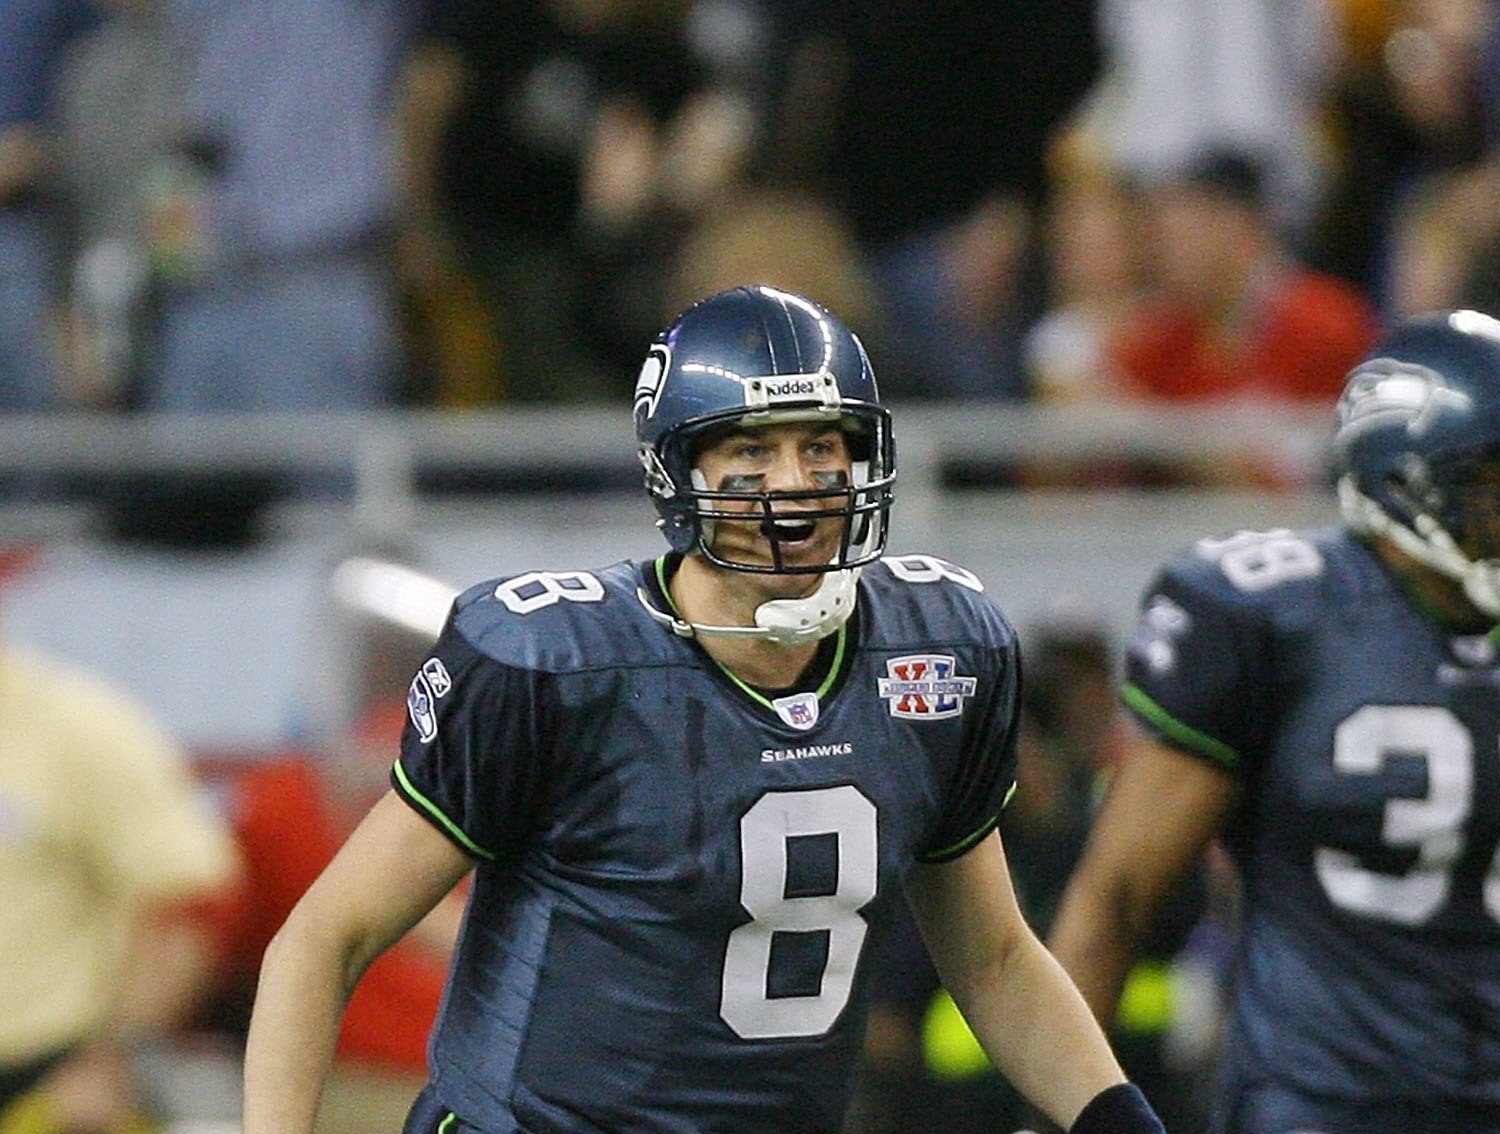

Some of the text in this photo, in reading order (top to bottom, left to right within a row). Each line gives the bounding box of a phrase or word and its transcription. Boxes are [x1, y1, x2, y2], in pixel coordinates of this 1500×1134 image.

[494, 571, 605, 615] 8
[880, 554, 984, 593] 8
[761, 743, 853, 762] SEAHAWKS
[719, 784, 878, 1039] 8
